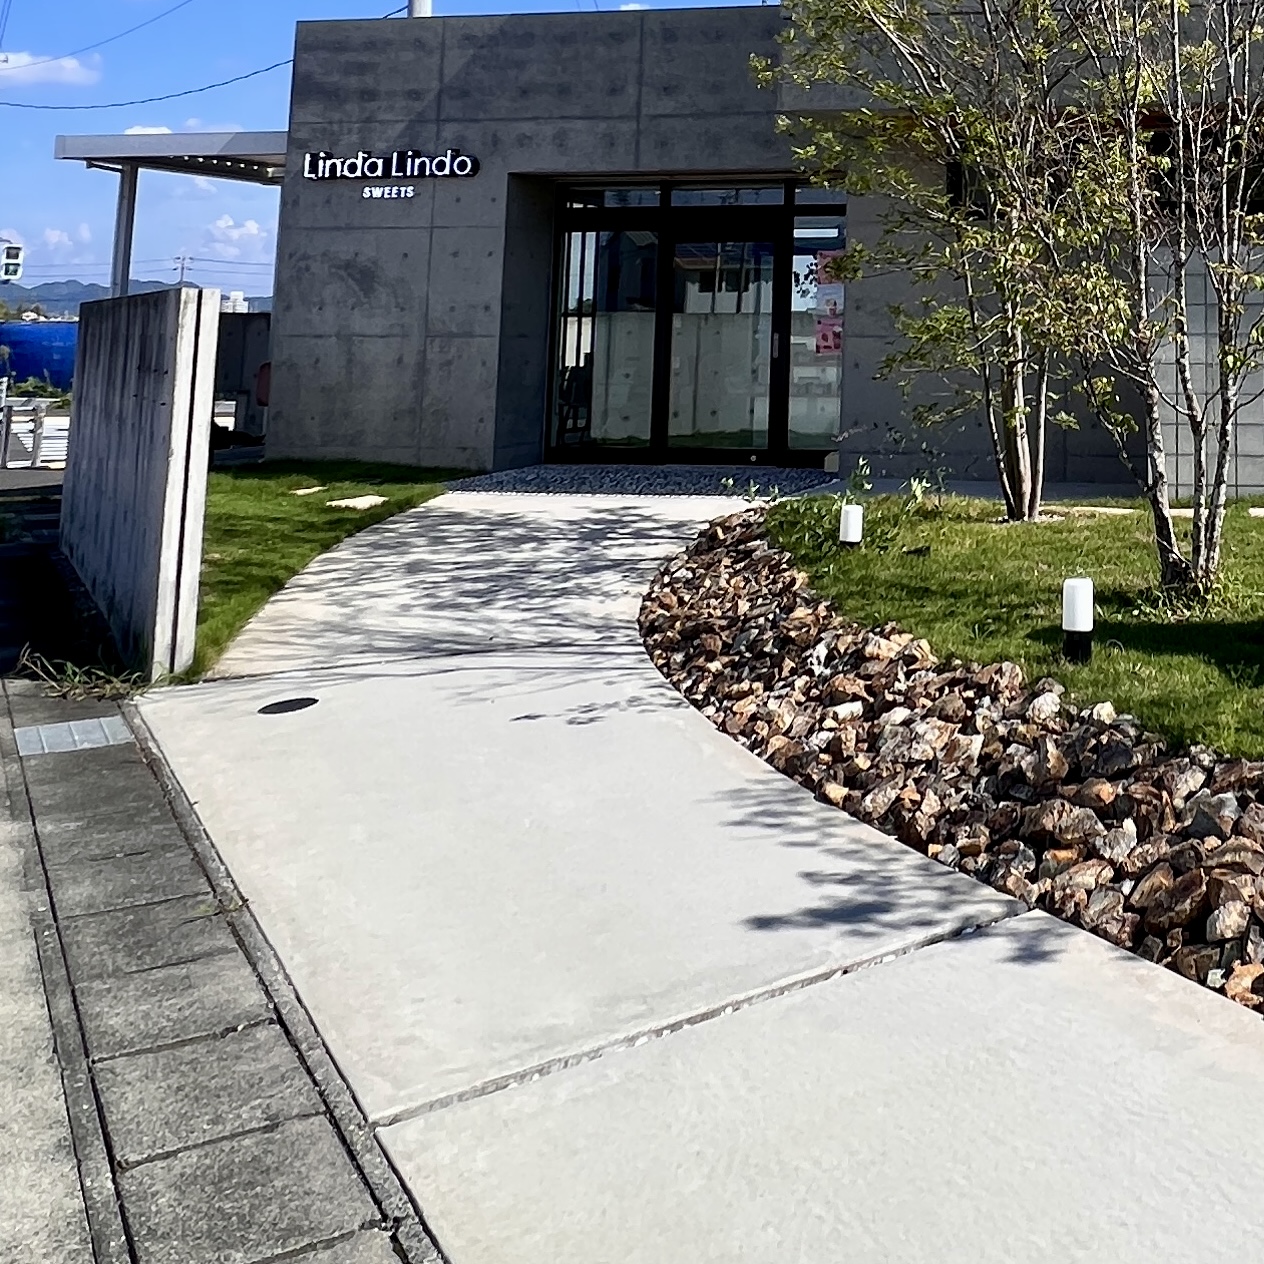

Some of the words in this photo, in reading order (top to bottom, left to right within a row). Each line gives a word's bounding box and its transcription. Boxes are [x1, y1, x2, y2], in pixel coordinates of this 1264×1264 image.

[303, 151, 384, 179] Linda
[391, 149, 473, 177] Lindo
[362, 186, 415, 199] SWEETS
